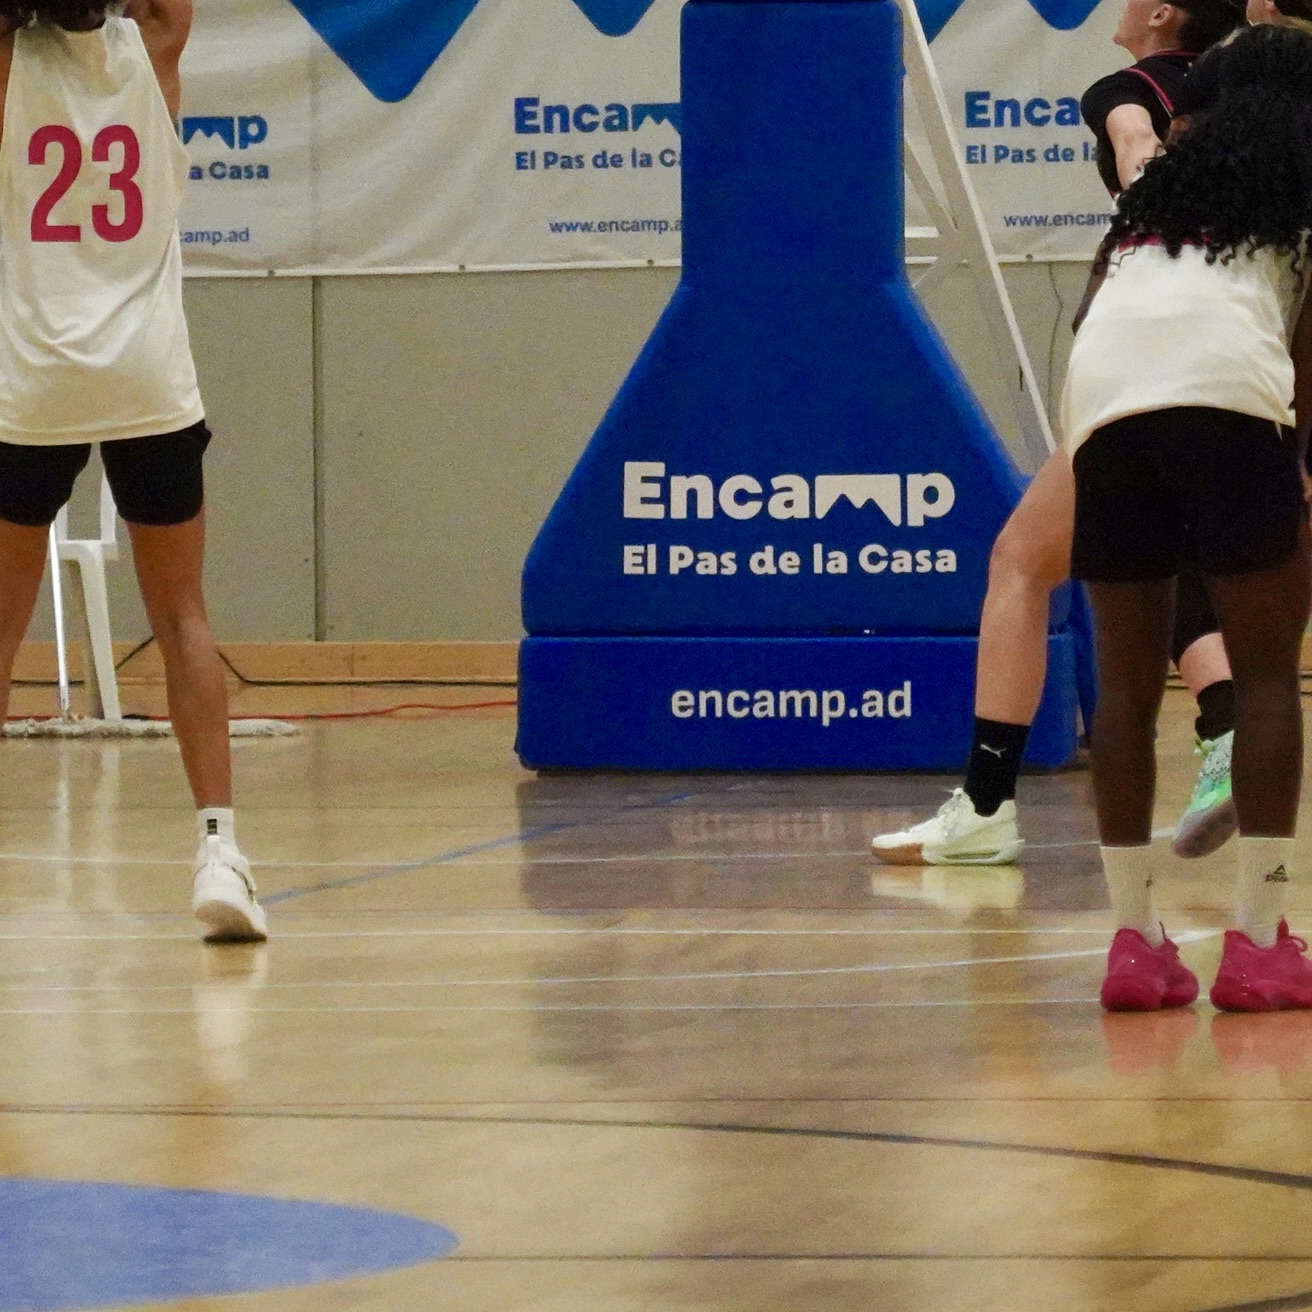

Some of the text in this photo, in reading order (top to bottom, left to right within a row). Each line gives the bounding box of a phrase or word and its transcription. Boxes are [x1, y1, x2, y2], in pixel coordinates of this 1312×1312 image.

[515, 150, 536, 170] El
[543, 151, 585, 170] Pas
[591, 150, 624, 169] de
[631, 148, 653, 168] la
[965, 144, 986, 164] El
[994, 144, 1036, 164] Pas
[1043, 144, 1075, 163] de
[27, 124, 144, 243] 23
[209, 161, 270, 180] Casa
[623, 461, 955, 527] Encamp
[623, 543, 957, 575] El Pas de la Casa
[671, 681, 912, 727] encamp.ad
